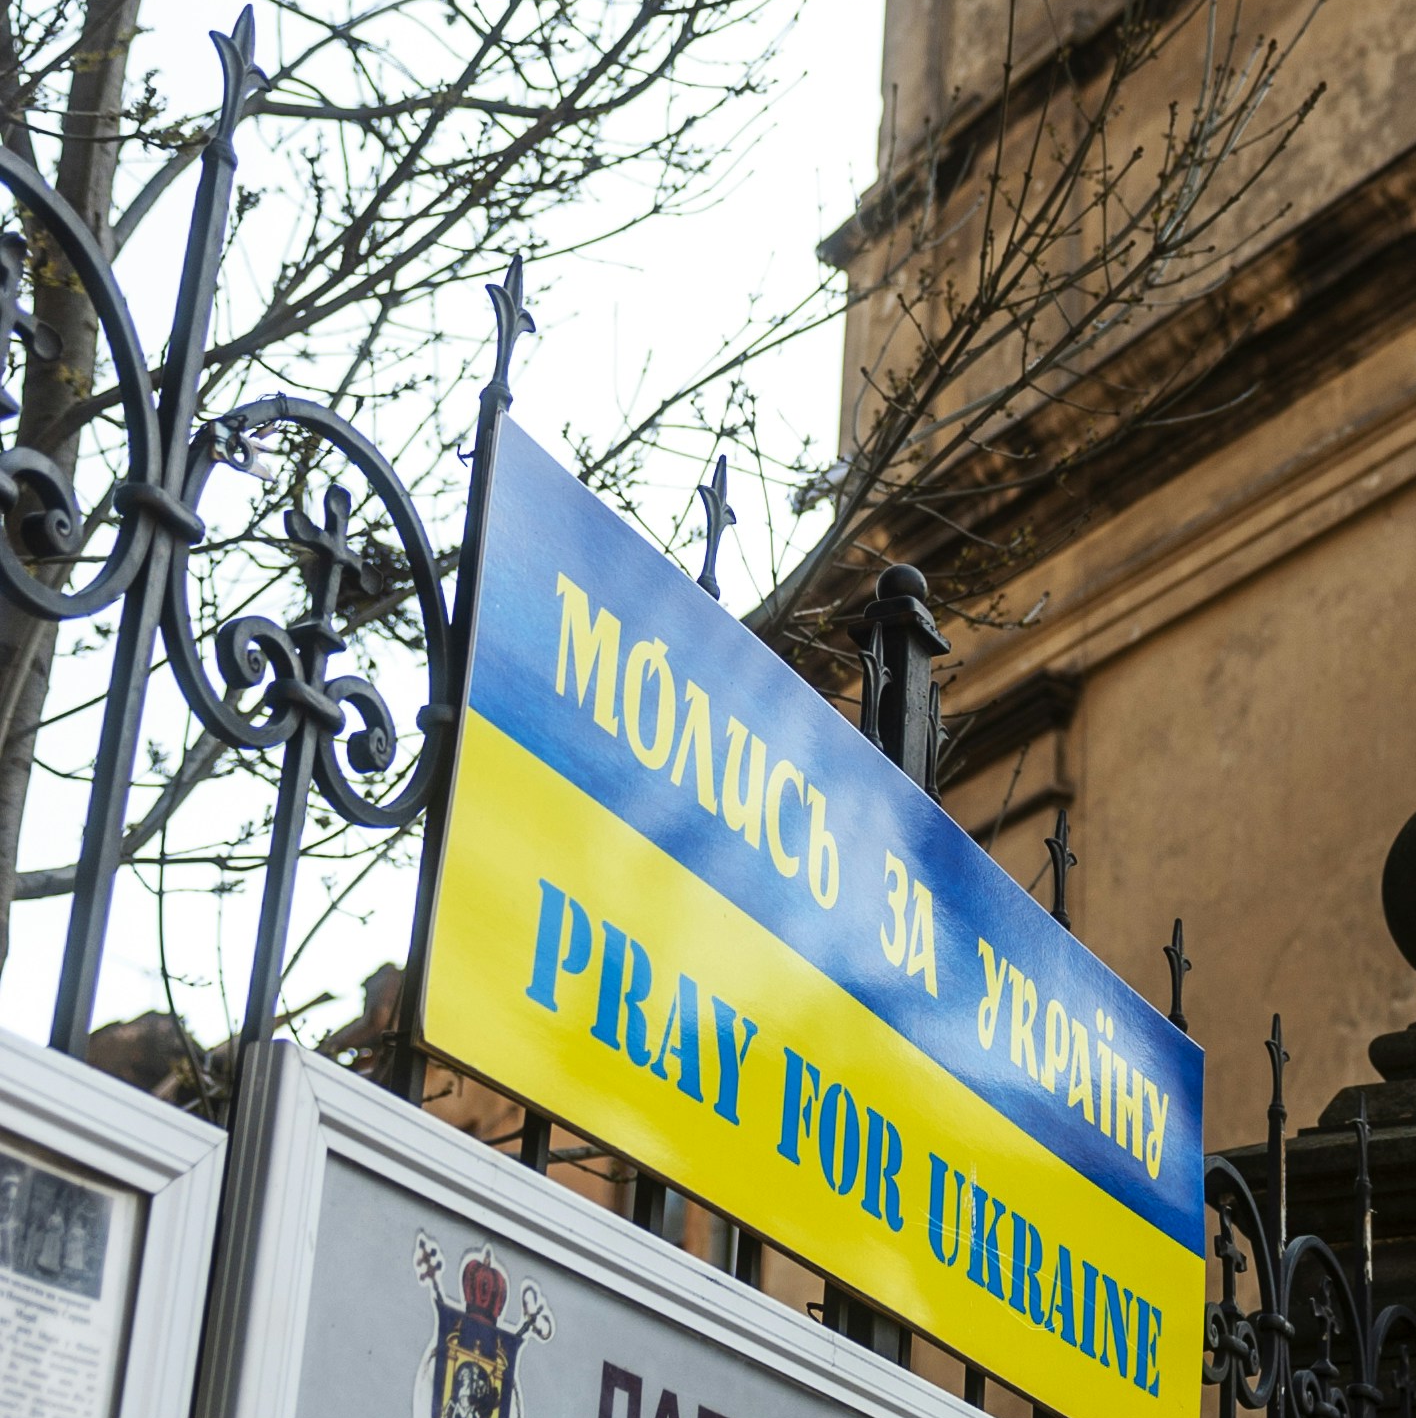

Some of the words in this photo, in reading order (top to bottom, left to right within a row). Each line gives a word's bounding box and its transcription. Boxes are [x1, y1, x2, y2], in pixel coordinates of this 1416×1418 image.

[524, 877, 759, 1128] PRAY
[775, 1044, 905, 1235] FOR
[927, 1149, 1165, 1399] UKRAINE
[879, 848, 940, 1001] ЗА
[975, 933, 1171, 1182] УКРАЇНУ
